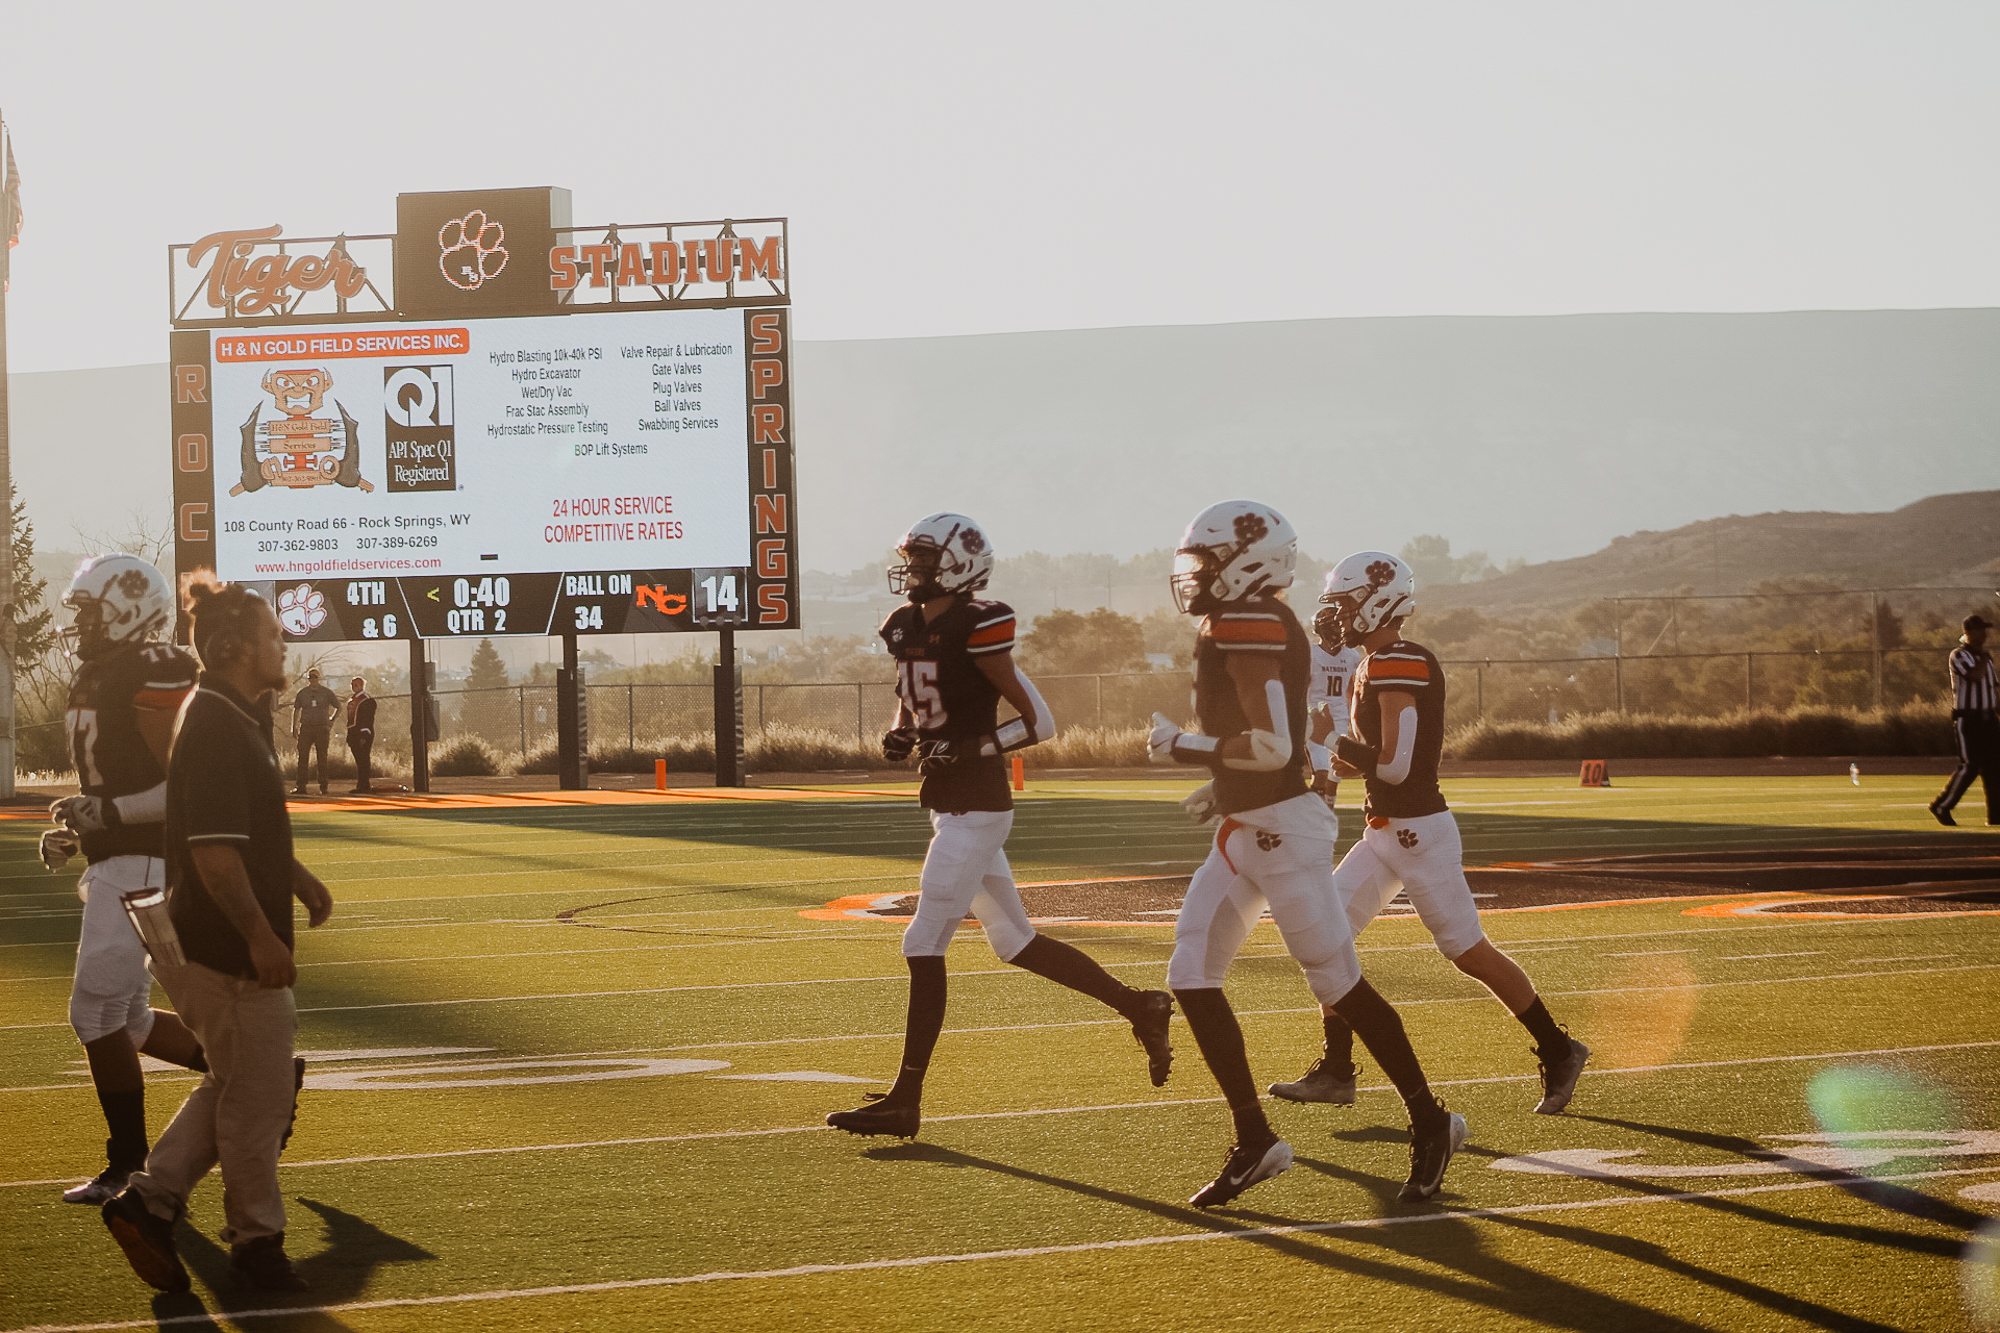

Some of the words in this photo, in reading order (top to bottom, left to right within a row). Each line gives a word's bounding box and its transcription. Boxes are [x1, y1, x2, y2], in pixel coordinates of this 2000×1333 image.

[187, 223, 366, 315] Tiger
[549, 236, 783, 291] STADIUM
[221, 342, 233, 356] H
[236, 341, 247, 356] &
[250, 341, 261, 355] N
[264, 339, 307, 355] GOLD
[310, 337, 353, 353] FIELD
[356, 335, 431, 351] SERVICES
[434, 333, 464, 348] INC.
[620, 346, 644, 358] Valve
[646, 344, 673, 360] Repair
[675, 344, 682, 356] &
[684, 342, 732, 356] Lubrication
[489, 351, 515, 367] Hydro
[517, 350, 552, 365] Blasting
[554, 348, 586, 361] 10k-40k
[588, 347, 603, 360] PSI
[511, 368, 537, 384] Hydro
[539, 367, 581, 380] Excavator
[652, 363, 671, 375] Gate
[673, 362, 702, 374] Valves
[521, 386, 555, 401] Wet/Dry
[556, 385, 573, 397] Vac
[652, 381, 671, 397] Plug
[673, 381, 702, 393] Valves
[506, 405, 525, 417] Frac
[527, 404, 546, 417] Stac
[548, 402, 589, 418] Assembly
[654, 399, 671, 412] Ball
[673, 399, 702, 411] Valves
[487, 422, 536, 439] Hydrostatic
[538, 421, 575, 434] Pressure
[577, 420, 608, 435] Testing
[638, 418, 680, 433] Swabbing
[682, 416, 719, 429] Services
[388, 441, 408, 458] API
[410, 440, 435, 463] Spec
[574, 444, 593, 456] BOP
[596, 443, 610, 455] Lift
[611, 443, 648, 458] Systems
[394, 461, 449, 487] Registered
[750, 314, 789, 624] SPRINGS
[553, 499, 568, 517] 24
[572, 498, 611, 516] HOUR
[614, 496, 673, 515] SERVICE
[224, 521, 245, 532] 108
[249, 520, 293, 533] County
[297, 518, 329, 530] Road
[332, 518, 347, 529] 66
[359, 516, 390, 528] Rock
[394, 515, 446, 530] Springs,
[450, 514, 471, 525] WY
[544, 523, 634, 543] COMPETITIVE
[638, 521, 683, 540] RATES
[258, 539, 339, 552] 307-362-9803
[356, 536, 438, 549] 307-389-6269
[255, 558, 442, 575] www.hngoldfieldservices.com
[347, 581, 386, 605] 4TH
[453, 577, 510, 608] 0:40
[565, 576, 604, 596] BALL
[608, 574, 632, 595] ON
[700, 575, 739, 612] 14
[362, 617, 378, 638] &
[383, 613, 397, 638] 6
[447, 609, 485, 634] QTR
[494, 609, 507, 632] 2
[574, 605, 603, 630] 34
[899, 661, 948, 730] 15
[1327, 675, 1342, 697] 10
[1582, 763, 1603, 784] 10
